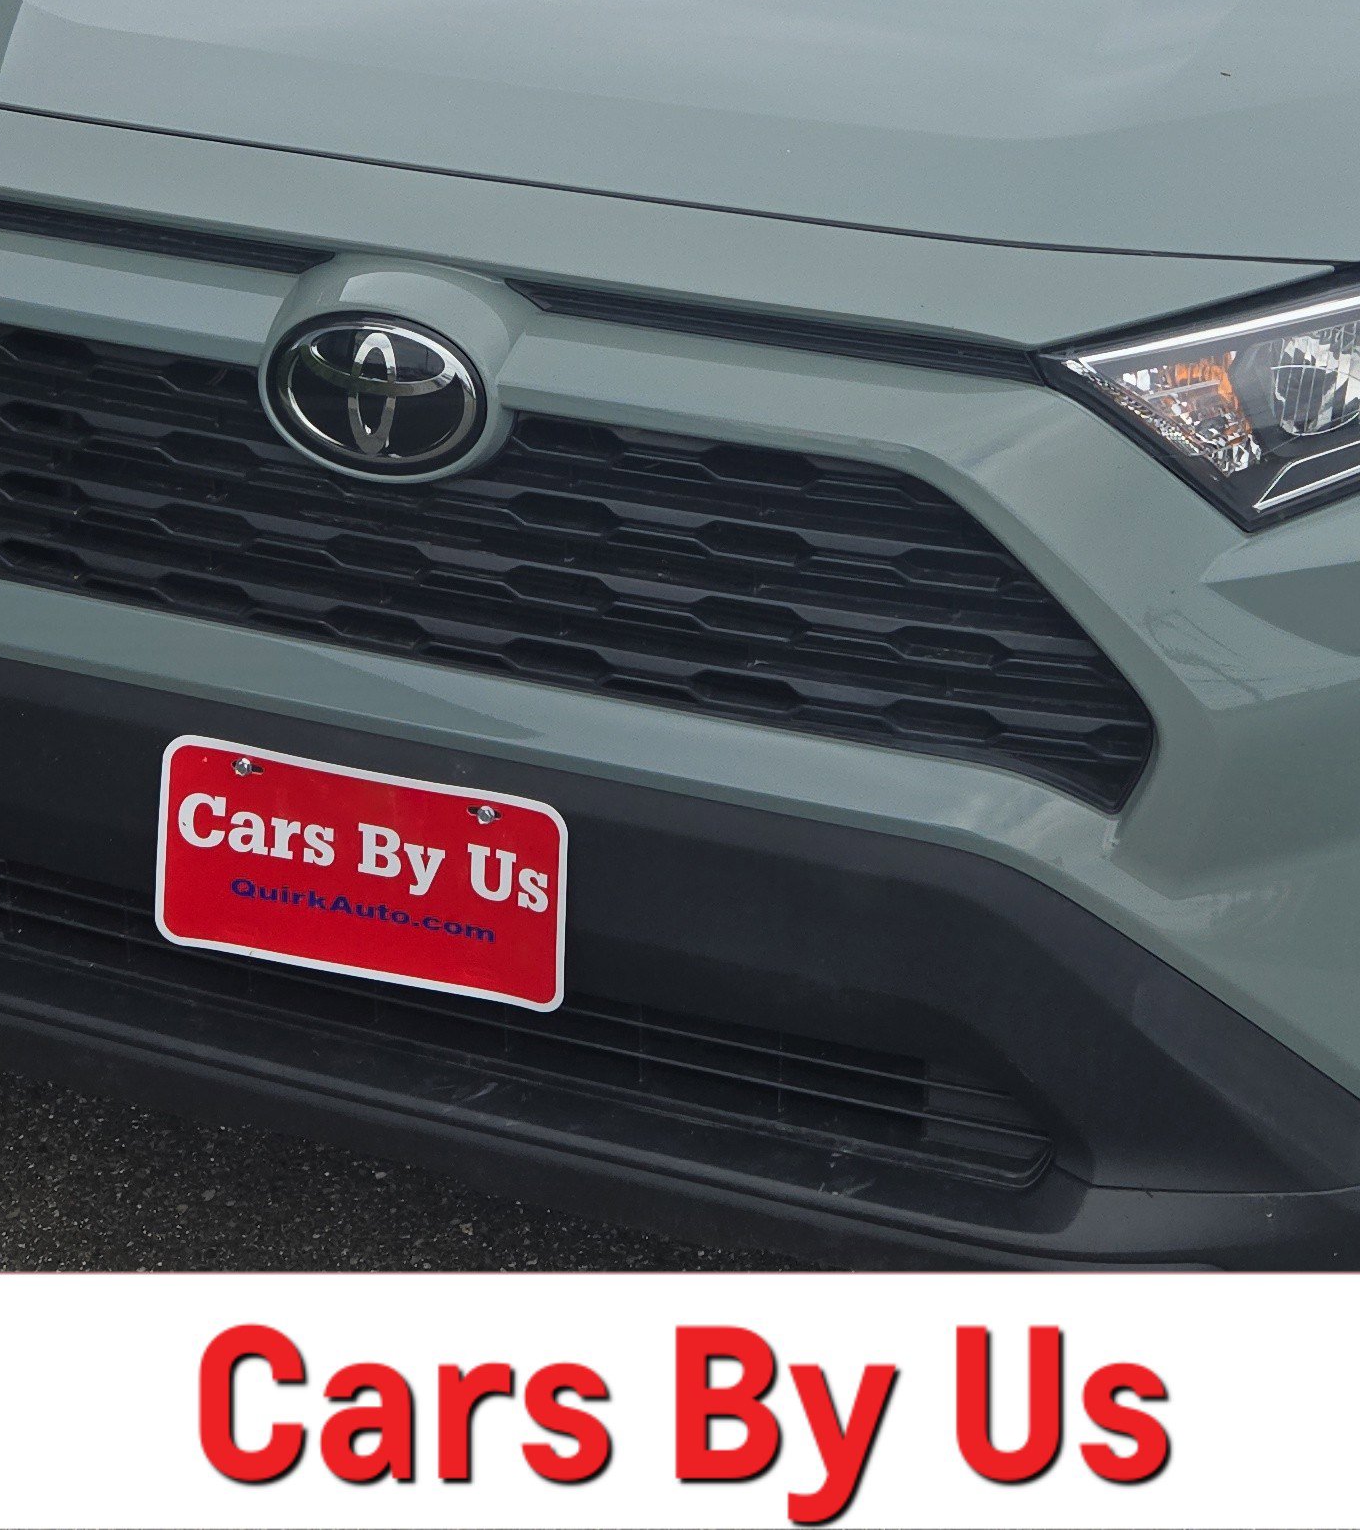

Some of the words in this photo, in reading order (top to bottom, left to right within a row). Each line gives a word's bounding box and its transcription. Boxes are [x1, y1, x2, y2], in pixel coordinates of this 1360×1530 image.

[178, 792, 335, 867] Cars
[357, 822, 446, 896] By
[467, 843, 549, 913] Us
[231, 878, 496, 943] QuirkAuto.com
